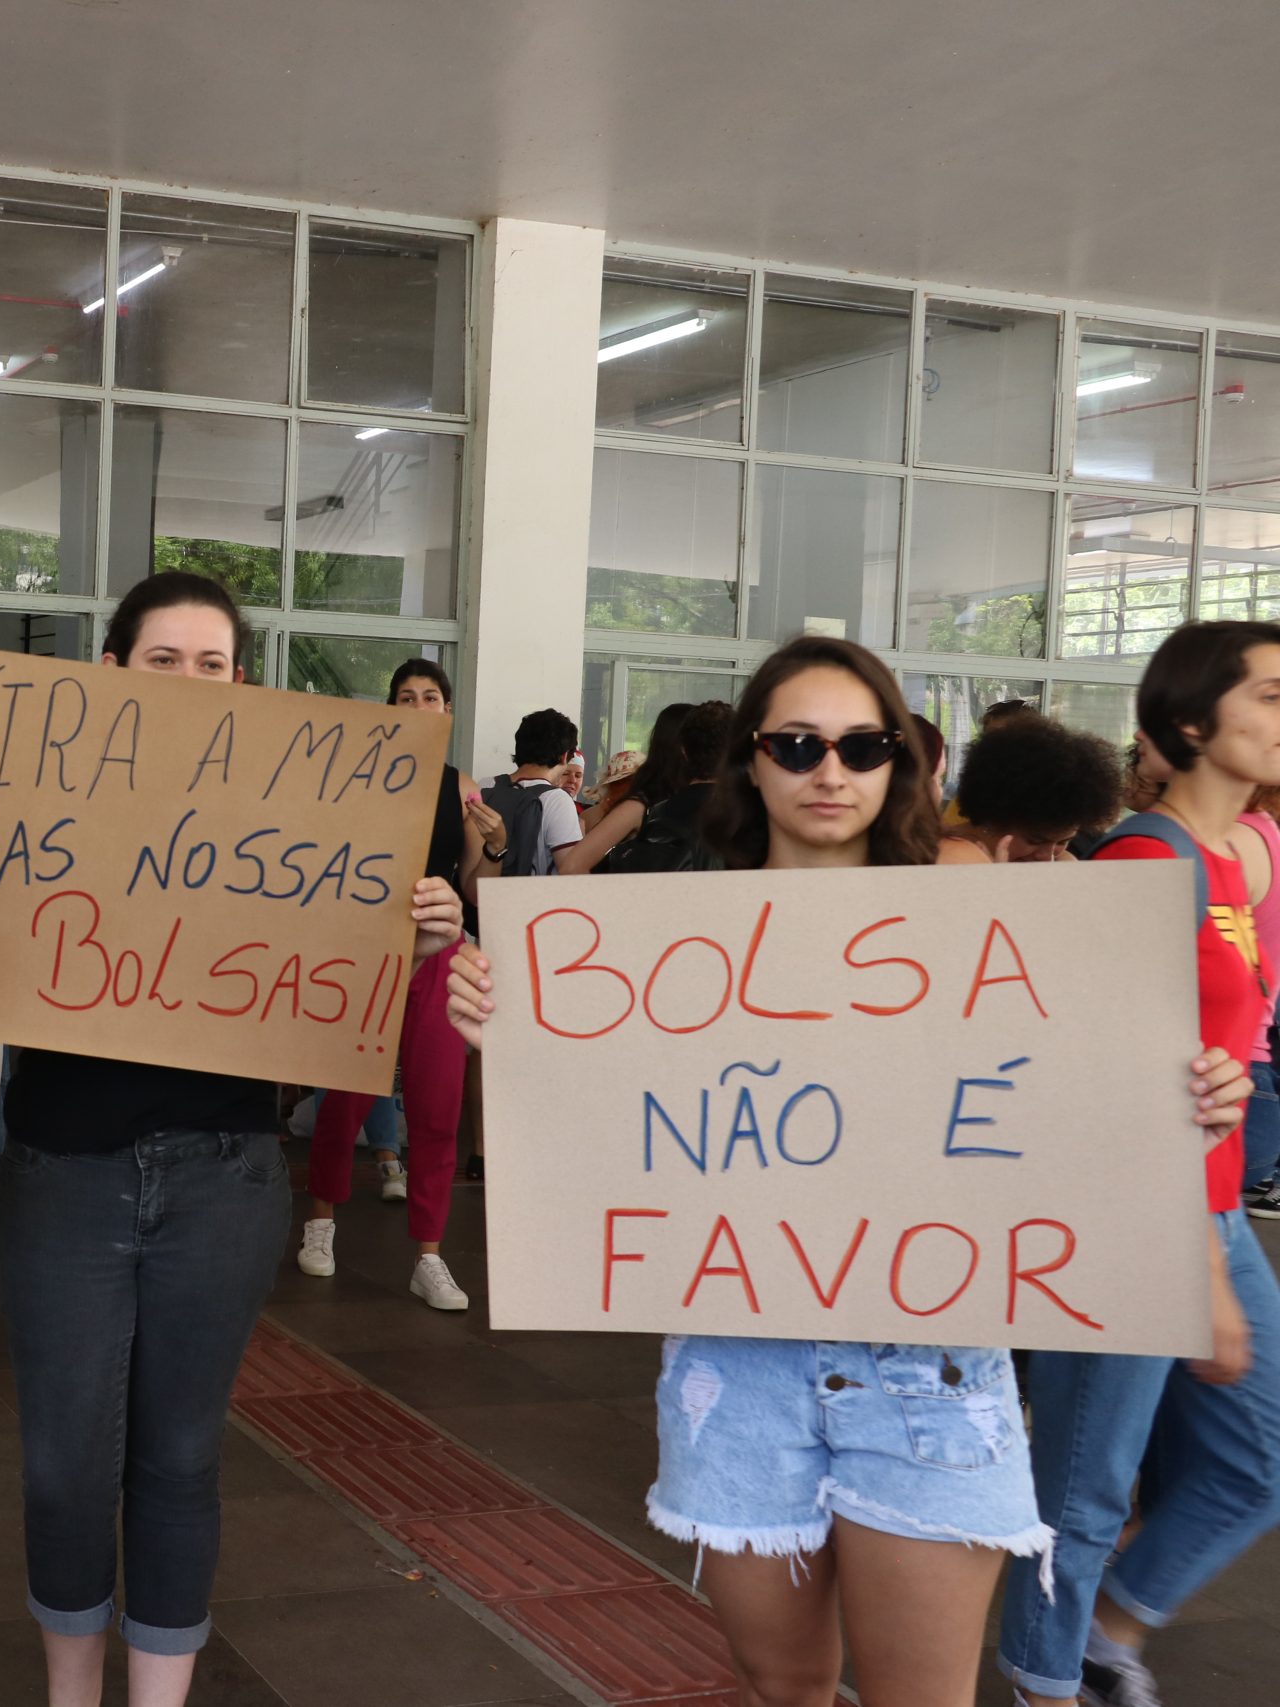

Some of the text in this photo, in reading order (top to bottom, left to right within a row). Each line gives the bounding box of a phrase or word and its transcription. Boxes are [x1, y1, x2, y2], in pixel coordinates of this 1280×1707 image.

[187, 711, 233, 792] A
[262, 723, 417, 803] MÃO
[126, 808, 394, 907] NOSSAS
[526, 901, 1049, 1040] BOLSA
[644, 1056, 1032, 1176] NÃO É
[602, 1208, 1105, 1332] FAVOR
